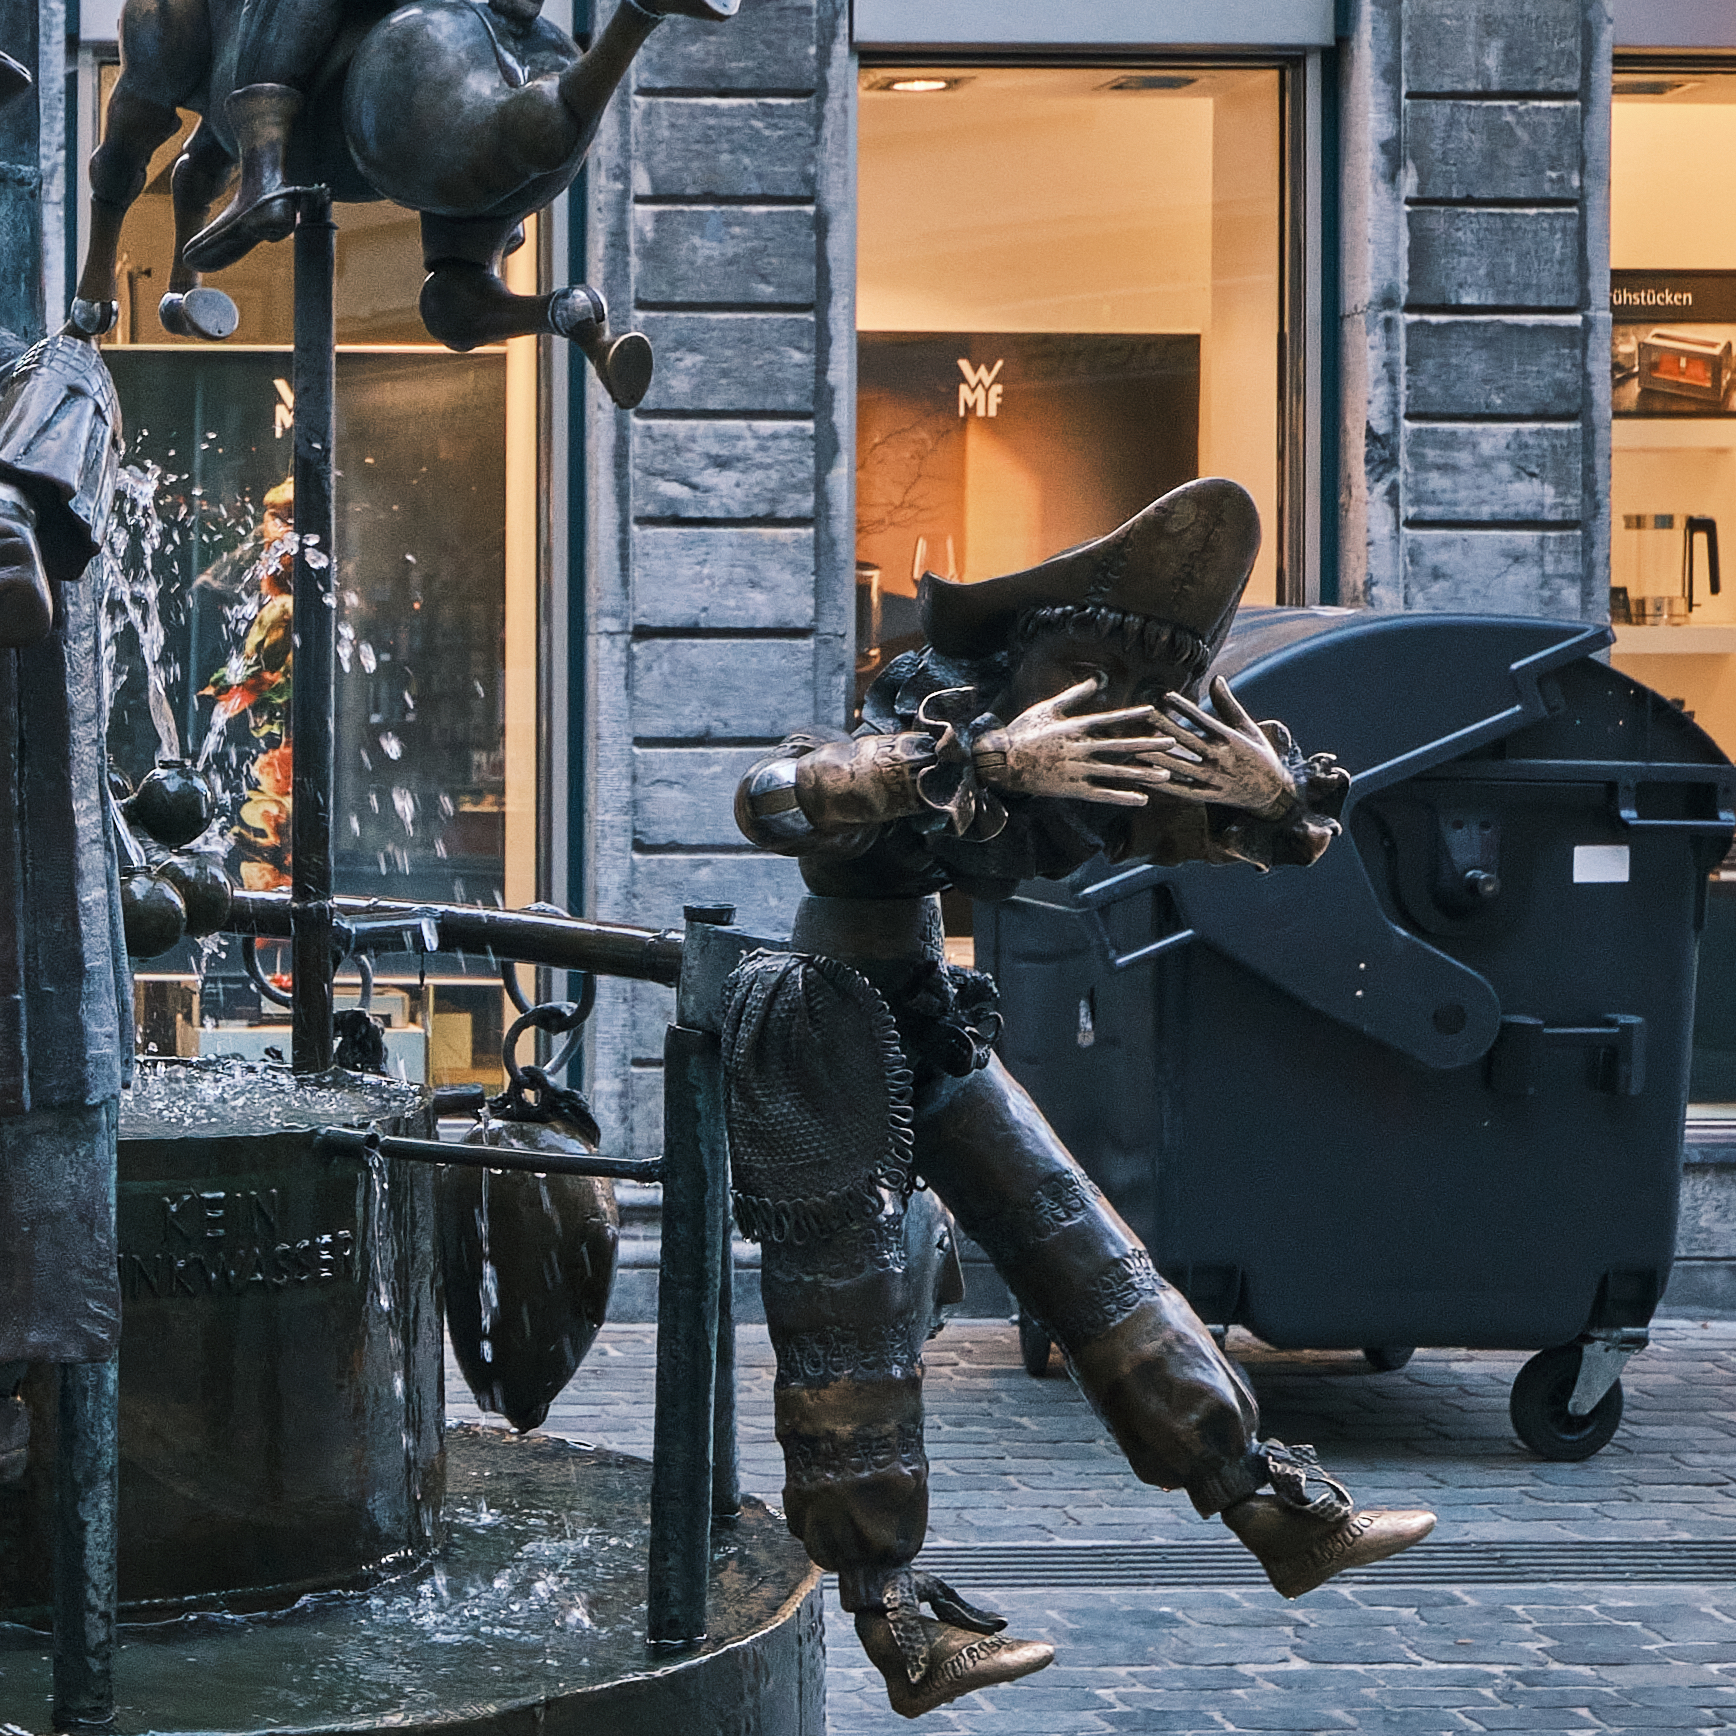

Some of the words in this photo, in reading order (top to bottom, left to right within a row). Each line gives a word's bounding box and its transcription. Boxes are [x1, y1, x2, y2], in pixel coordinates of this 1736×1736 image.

[1612, 286, 1693, 306] ühstücken
[956, 358, 1004, 418] WMF
[161, 1188, 279, 1243] KEIN
[115, 1228, 355, 1298] INKWASSER
